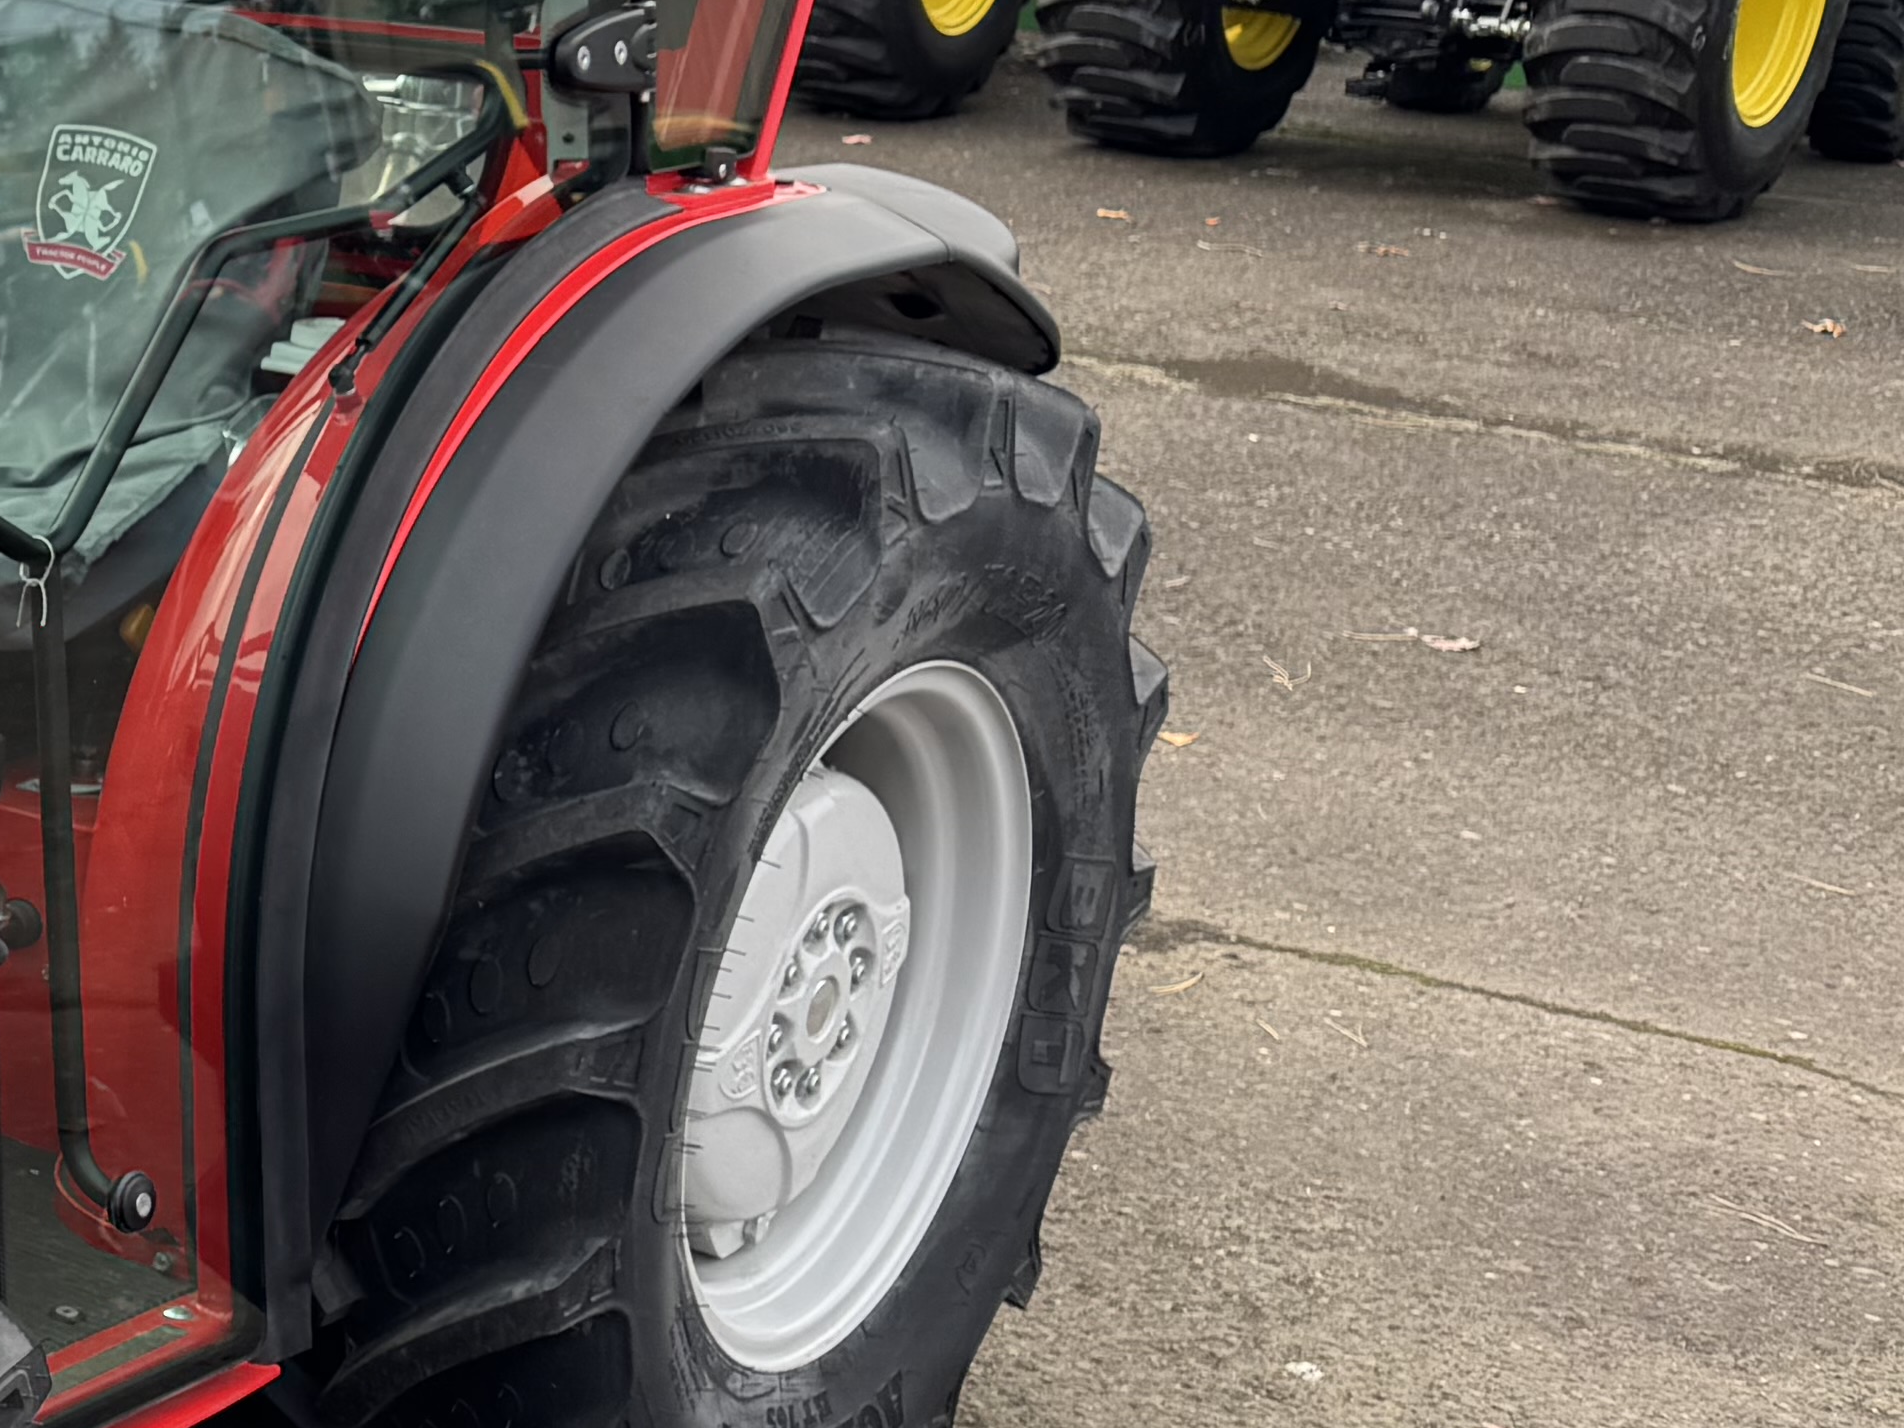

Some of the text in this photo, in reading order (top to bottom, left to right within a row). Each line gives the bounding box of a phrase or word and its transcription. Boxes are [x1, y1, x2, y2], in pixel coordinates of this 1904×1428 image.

[56, 144, 144, 178] CARRARO
[58, 133, 150, 162] ANTONIO
[1019, 854, 1116, 1093] BKT
